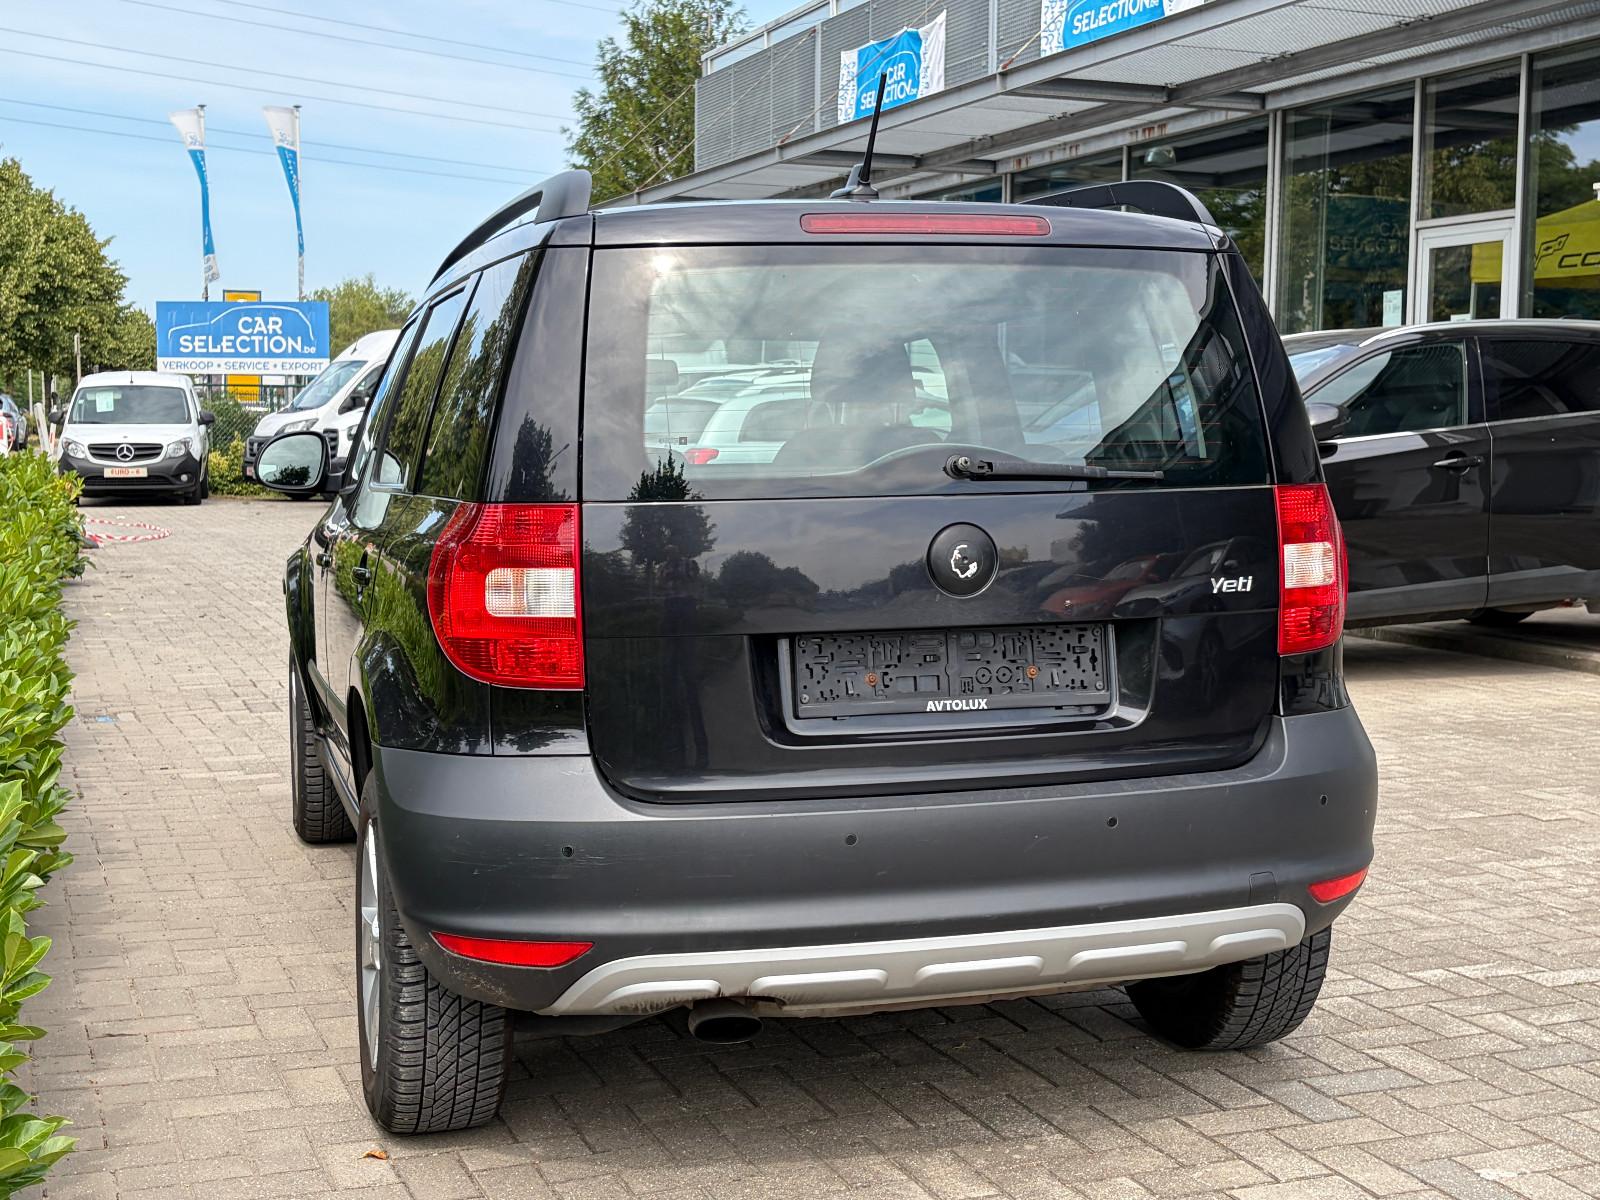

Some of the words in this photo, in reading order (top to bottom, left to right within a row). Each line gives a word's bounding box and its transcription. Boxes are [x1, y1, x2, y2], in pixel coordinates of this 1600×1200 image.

[886, 63, 906, 85] CAR
[860, 79, 918, 110] SELCTION.be
[238, 316, 282, 335] CAR
[179, 335, 316, 354] SELECTION.be
[162, 360, 214, 371] VERKOOP
[224, 360, 270, 371] SERVICE
[281, 361, 324, 371] EXPORT
[1210, 575, 1253, 594] Yeti
[926, 698, 988, 712] AVTOLUX
